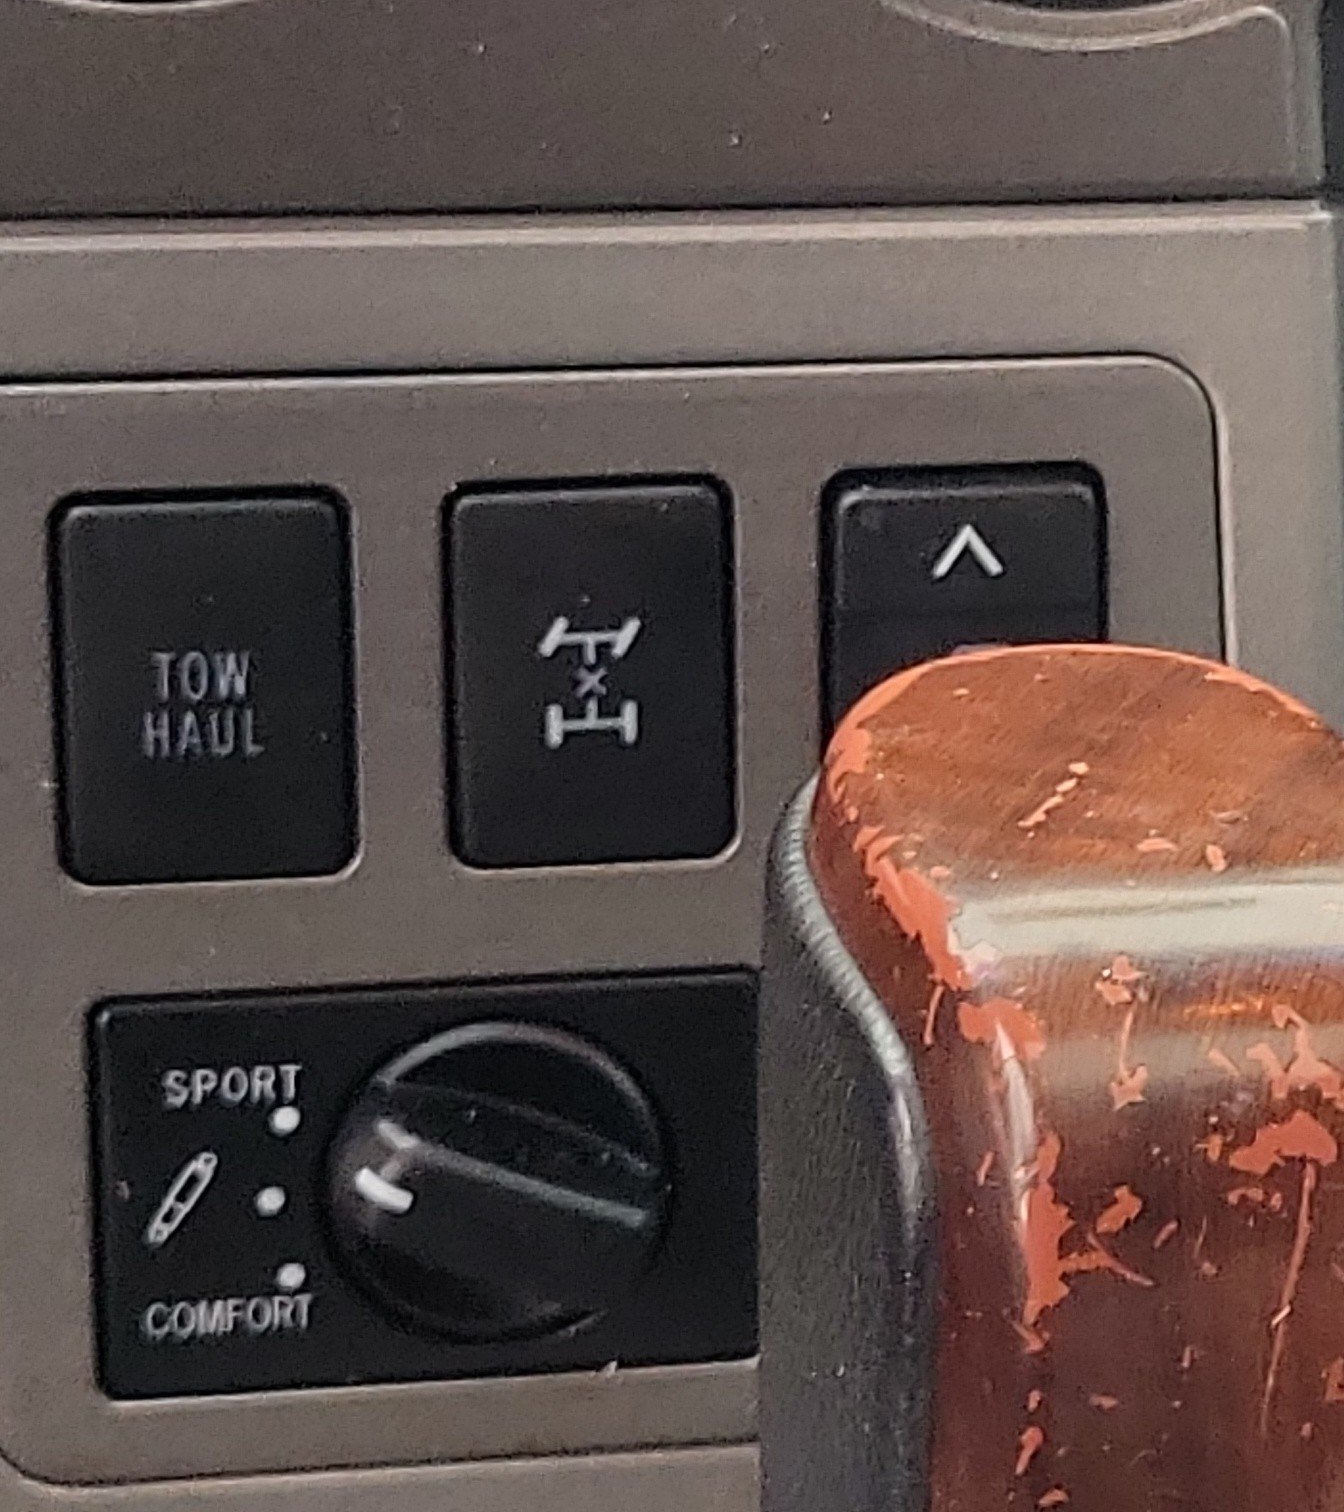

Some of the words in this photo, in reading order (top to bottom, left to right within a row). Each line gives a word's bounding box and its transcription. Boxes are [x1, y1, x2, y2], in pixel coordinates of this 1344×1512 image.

[150, 649, 251, 702] TOW
[141, 707, 265, 760] HAUL
[160, 1063, 303, 1110] SPORT
[141, 1292, 315, 1340] COMFORT
